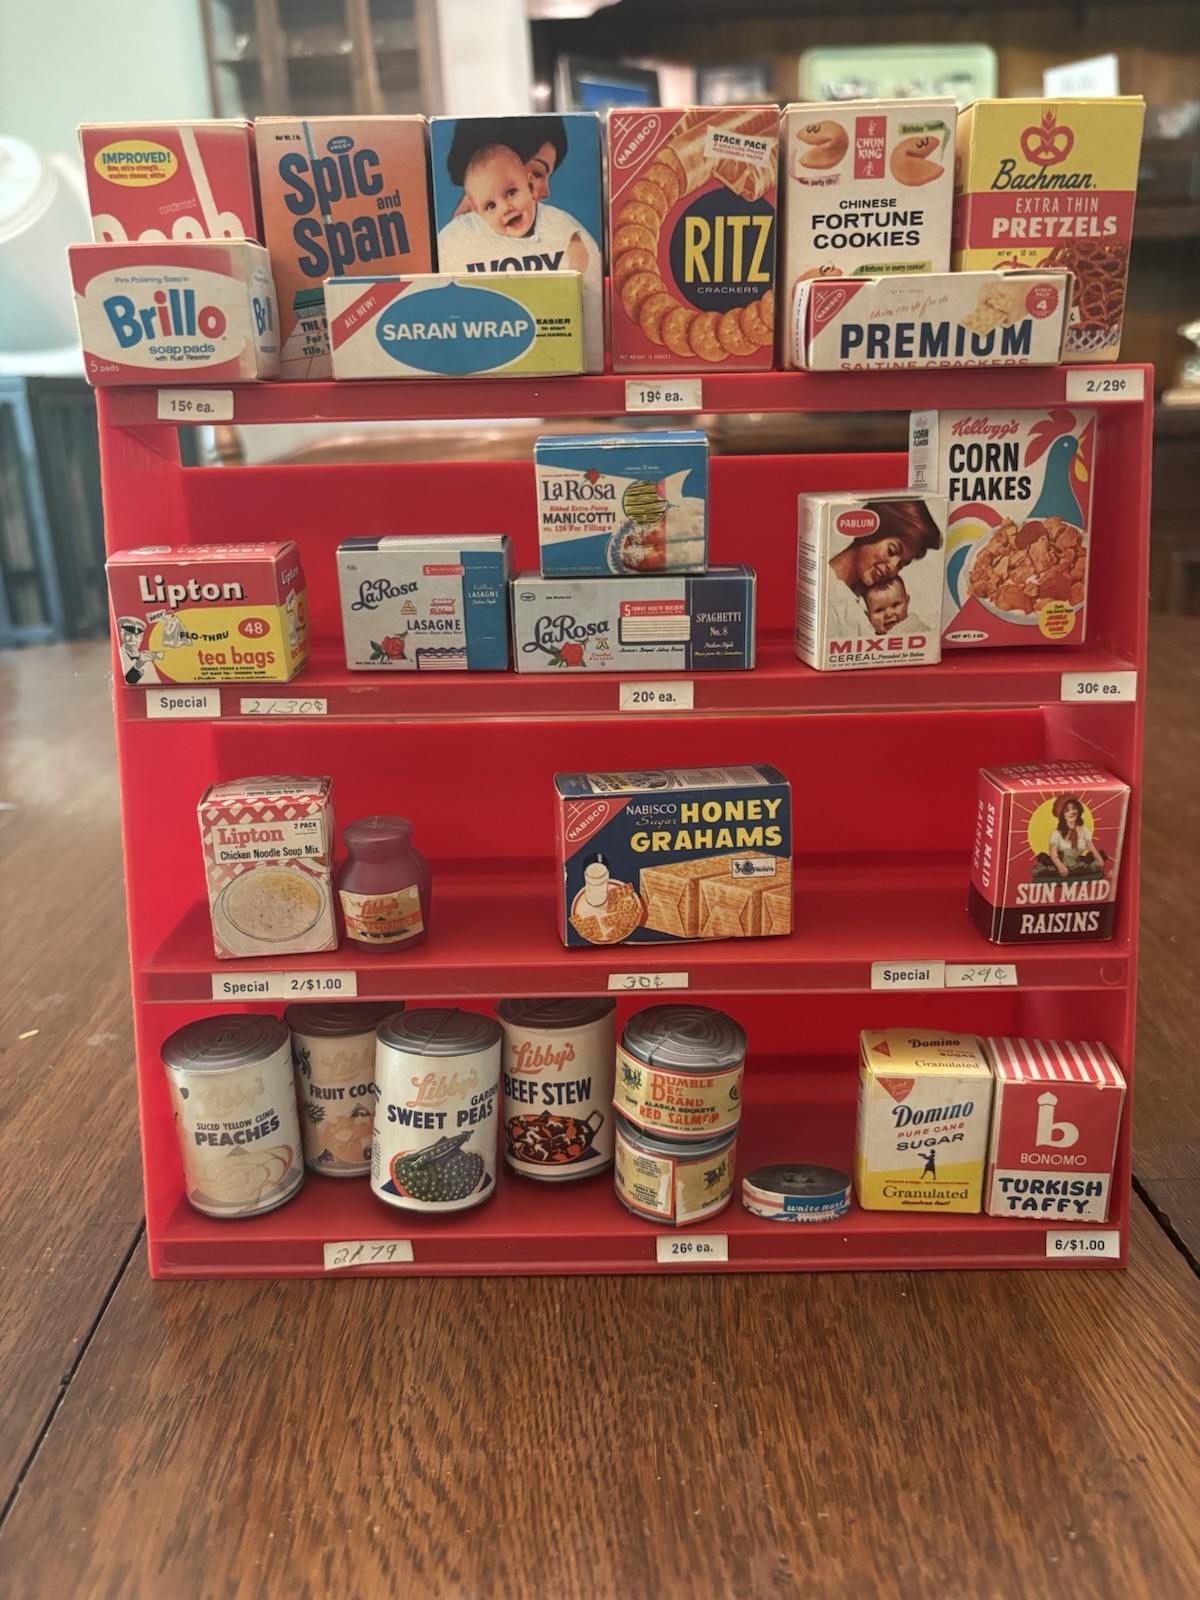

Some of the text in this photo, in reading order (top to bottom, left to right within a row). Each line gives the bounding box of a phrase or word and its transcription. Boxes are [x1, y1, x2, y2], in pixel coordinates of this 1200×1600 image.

[617, 119, 657, 165] NABISCO
[713, 133, 767, 151] STACK PACK
[857, 138, 884, 148] CHUN
[102, 152, 171, 164] IMPROVED!
[858, 149, 882, 159] KING
[279, 149, 384, 215] Spic
[991, 159, 1092, 189] Bachman
[376, 190, 402, 210] and
[839, 199, 897, 209] CHINESE
[1016, 197, 1099, 213] EXTRA THIN
[812, 211, 924, 230] FORTUNE
[992, 216, 1117, 238] PRETZELS
[293, 211, 410, 278] Span
[813, 231, 920, 249] COOKIES
[684, 215, 773, 283] RITZ
[467, 251, 565, 273] ORY
[131, 276, 163, 285] Polishing
[697, 286, 759, 294] CRACKERS
[344, 313, 358, 329] ALL
[356, 296, 377, 317] NEW!
[817, 291, 843, 320] NABISCO
[1036, 300, 1047, 311] 4
[103, 289, 227, 349] Brillo
[383, 320, 529, 341] SARAN WRAP
[840, 318, 1033, 360] PREMIUM
[149, 344, 216, 355] soap pads
[90, 360, 120, 373] 5 pads
[1086, 379, 1126, 393] 2/29¢
[639, 391, 683, 403] 19¢ ea.
[171, 400, 214, 413] 15¢ ea.
[913, 429, 929, 439] CORN
[951, 416, 1019, 439] Kellogg's
[949, 443, 1020, 473] CORN
[949, 476, 1031, 501] FLAKES
[543, 512, 615, 524] MANICOTTI
[840, 518, 874, 528] PABLUM
[281, 567, 299, 586] Lipton
[139, 575, 245, 608] Lipton
[624, 604, 631, 616] 5
[696, 612, 741, 623] SPAGHETTI
[244, 622, 263, 635] 48
[407, 620, 461, 630] LASAGNE
[710, 626, 729, 637] No. 8
[180, 631, 229, 641] FLO-THRU
[830, 636, 927, 654] MIXED
[198, 650, 226, 665] tea
[231, 646, 275, 668] bags
[829, 653, 877, 663] CEREAL
[633, 692, 676, 702] 20¢ ea.
[1077, 683, 1121, 694] 30¢ ea.
[160, 697, 207, 710] Special
[1019, 774, 1106, 786] RAISINS
[626, 798, 783, 824] NABISCO HONEY
[569, 804, 606, 839] NABISCO
[636, 815, 677, 828] Sugar
[217, 828, 284, 849] Lipton
[630, 826, 783, 853] GRAHAMS
[973, 799, 984, 869] RAISINS
[221, 845, 320, 861] Chicken Noodle Soup Mix
[982, 802, 995, 888] SUN MAID
[1016, 879, 1111, 905] SUN MAID
[1020, 911, 1100, 935] RAISINS
[623, 974, 664, 989] 30¢
[883, 969, 930, 981] Special
[223, 979, 342, 993] Special 2/$1.00
[908, 1038, 960, 1048] Domino
[510, 1041, 575, 1075] Libby's
[915, 1059, 979, 1068] Granulated
[310, 1084, 345, 1100] FRUIT
[406, 1069, 479, 1108] Libby's
[504, 1072, 592, 1105] BEEF STEW
[387, 1099, 493, 1129] SWEET PEAS
[644, 1101, 676, 1112] ALASKA
[892, 1101, 974, 1129] Domino
[196, 1107, 275, 1131] SLICED YELLOW CLING
[639, 1106, 719, 1125] RED SALMON
[194, 1115, 280, 1146] PEACHES
[897, 1122, 965, 1139] PURE CANE
[896, 1133, 964, 1152] SUGAR
[1020, 1153, 1087, 1166] BONOMO
[883, 1185, 969, 1200] Granulated
[998, 1178, 1103, 1197] TURKISH
[822, 1200, 844, 1211] Rose
[1006, 1196, 1090, 1214] TAFFY
[672, 1243, 713, 1254] 26¢ ea.
[1055, 1239, 1105, 1251] 6/$1.00
